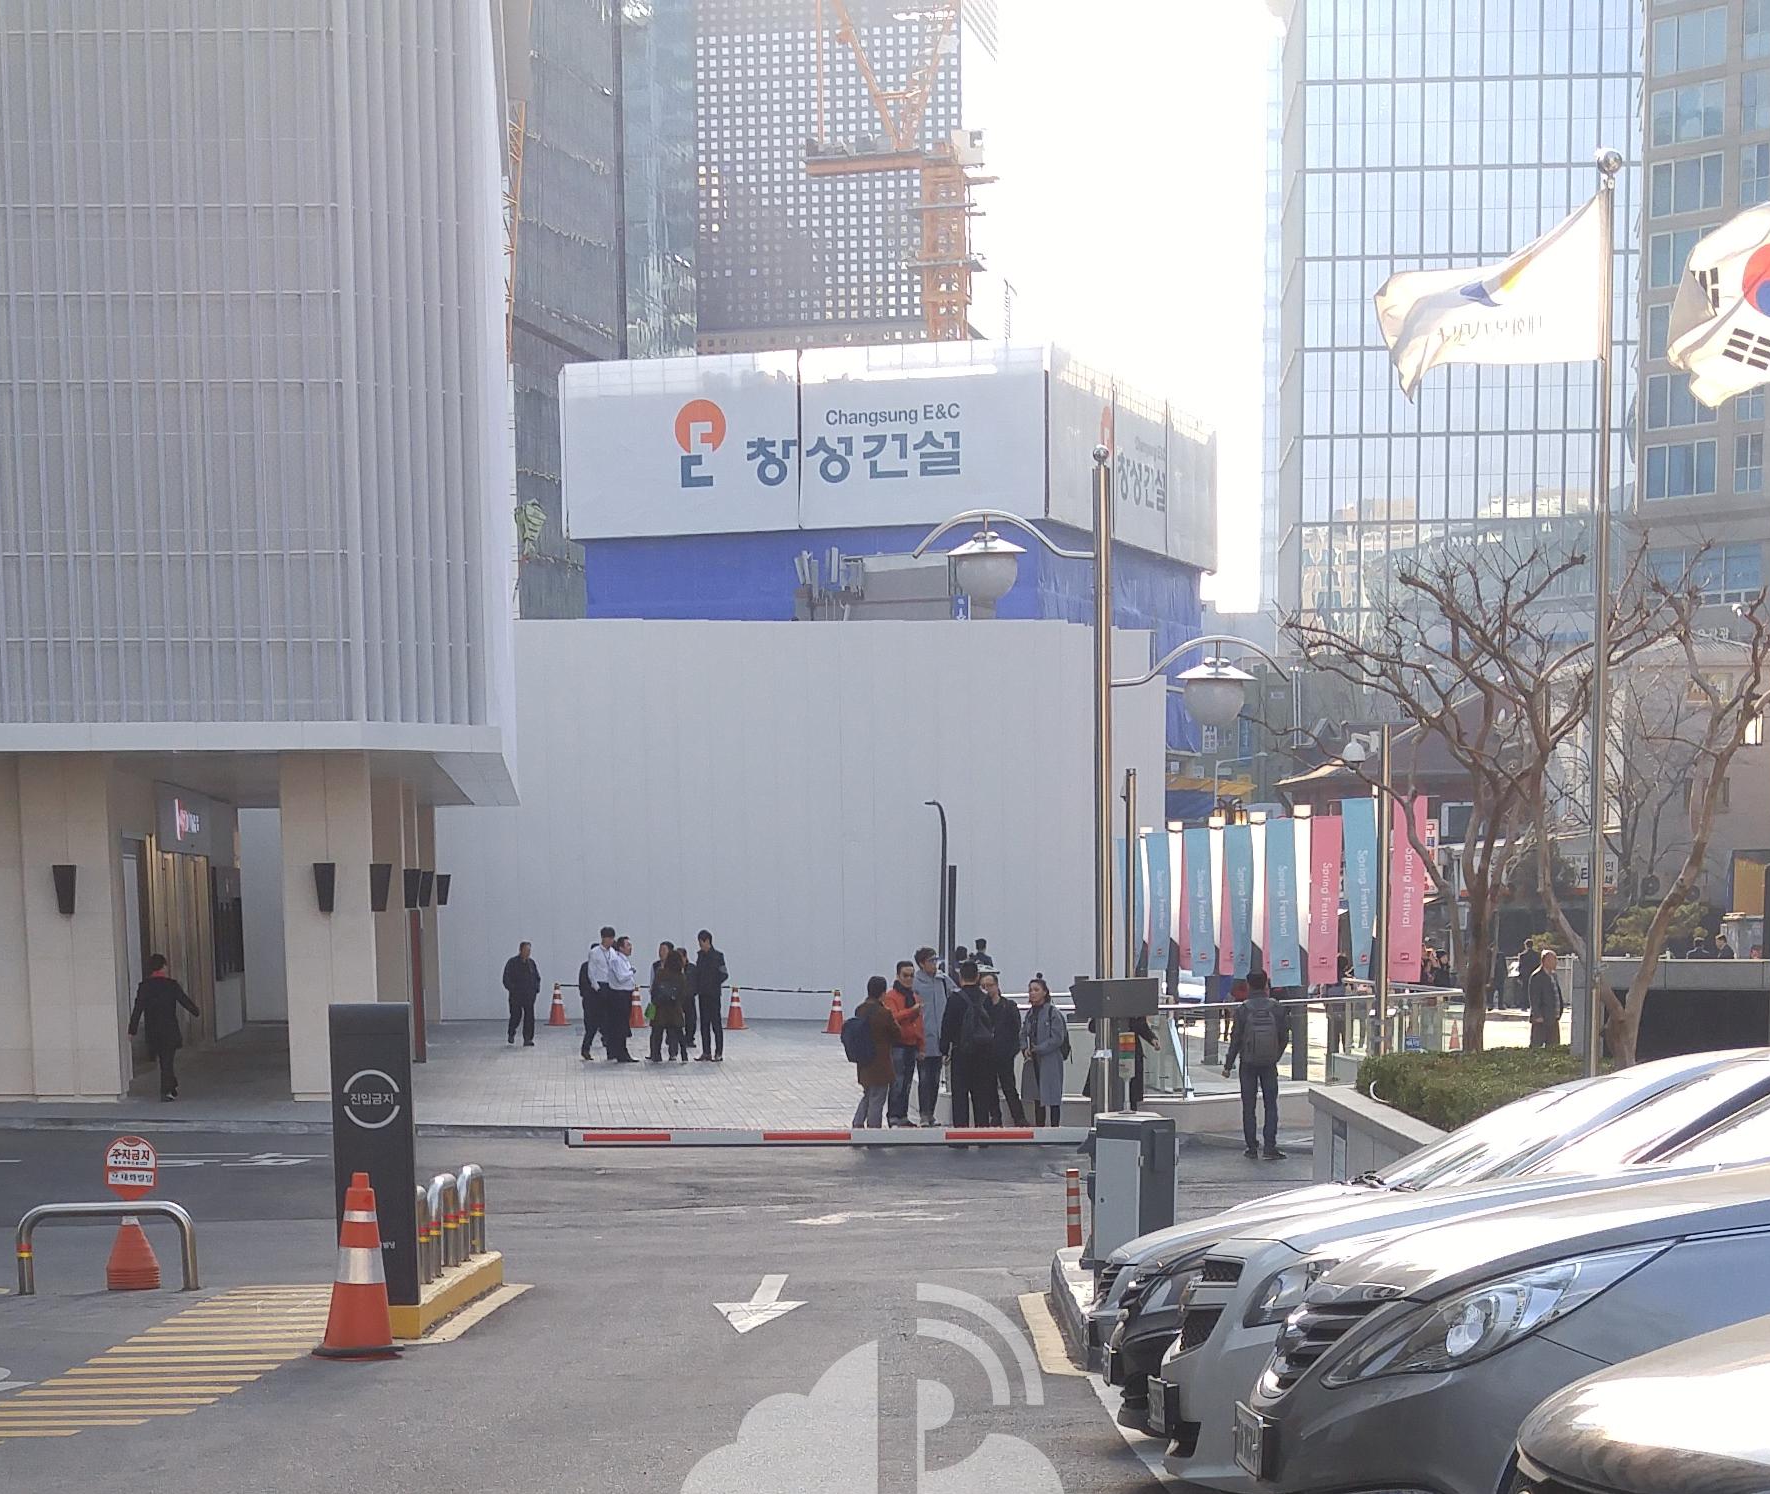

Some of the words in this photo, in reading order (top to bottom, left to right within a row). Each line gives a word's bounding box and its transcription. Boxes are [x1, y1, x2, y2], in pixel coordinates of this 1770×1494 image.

[826, 409, 919, 428] Changsung
[923, 403, 961, 420] E&C
[746, 430, 962, 487] 창성건설
[1277, 865, 1289, 896] Spring
[1320, 862, 1333, 895] Spring
[1357, 849, 1369, 885] Spring
[1403, 847, 1417, 882] Spring
[1279, 899, 1290, 937] Festival
[1401, 886, 1415, 928] Festival
[350, 1093, 394, 1105] 진입금지
[109, 1148, 150, 1161] 주차금지
